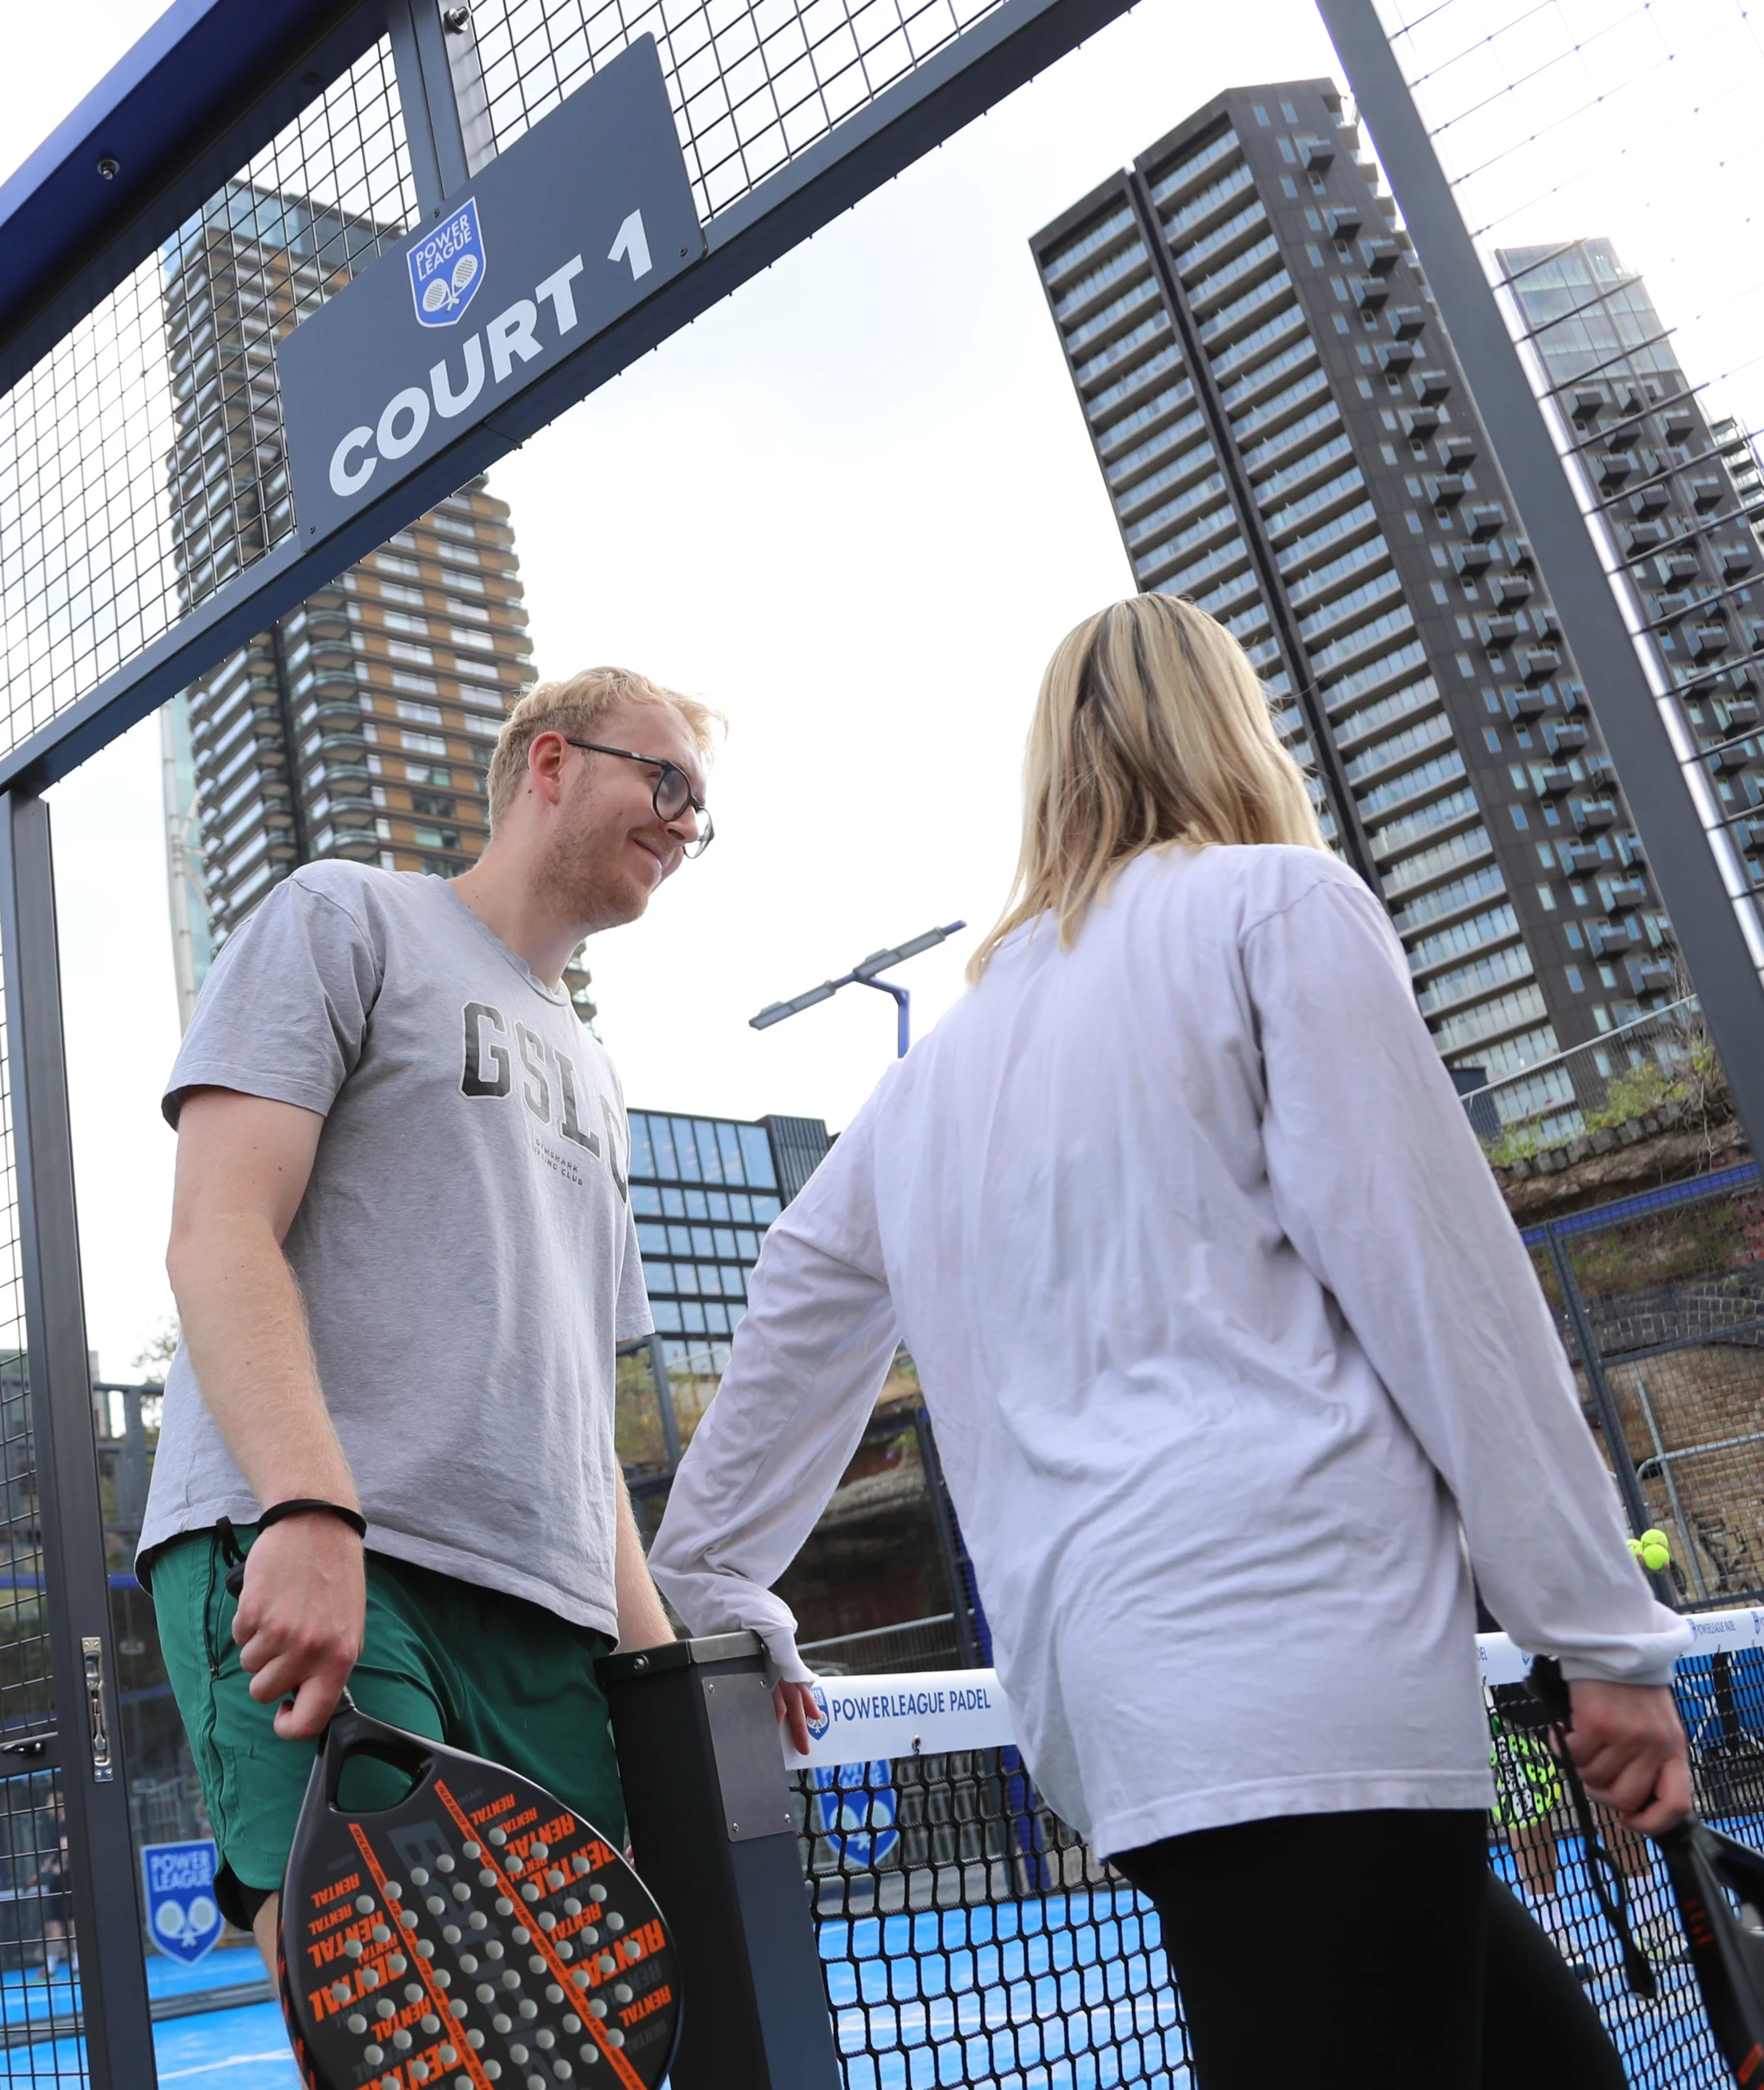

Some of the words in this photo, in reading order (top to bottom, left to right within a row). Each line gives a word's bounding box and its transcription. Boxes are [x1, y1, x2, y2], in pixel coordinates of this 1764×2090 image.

[415, 213, 469, 268] POWER
[417, 227, 473, 282] LEAGUE
[329, 253, 584, 496] COURT
[607, 207, 653, 281] 1
[535, 1138, 579, 1173] GYMSHARK
[561, 1168, 583, 1186] CLUB
[831, 1692, 945, 1722] POWERLEAGUE
[949, 1688, 992, 1712] PADEL
[469, 1793, 516, 1826] RENTAL
[496, 1806, 539, 1834] RENTA
[149, 1849, 211, 1874] POWER
[152, 1867, 213, 1892] LEAGUE
[310, 1873, 361, 1909] RENTAL
[308, 1904, 353, 1937] RENTAL
[370, 1995, 433, 2043] RENTAL
[618, 1984, 673, 2028] RENTAL
